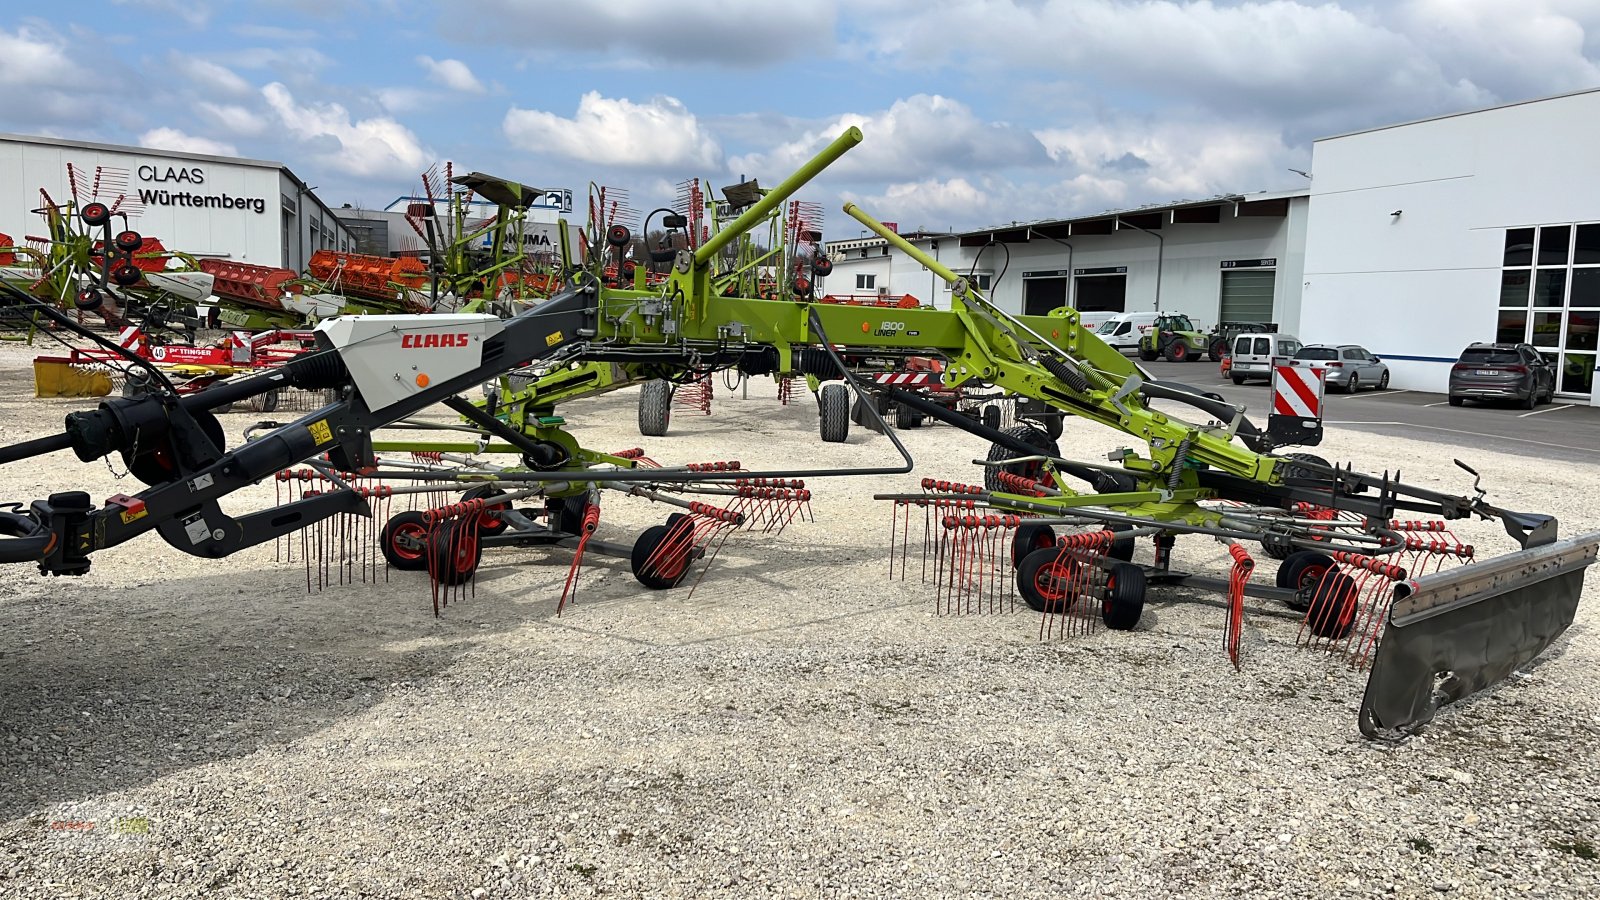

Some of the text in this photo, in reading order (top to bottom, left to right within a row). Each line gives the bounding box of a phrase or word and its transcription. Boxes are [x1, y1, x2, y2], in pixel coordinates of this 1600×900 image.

[138, 165, 204, 184] CLAAS
[138, 189, 265, 213] Württemberg
[881, 321, 905, 330] 1800
[401, 333, 469, 348] CLAAS
[154, 348, 164, 358] 40
